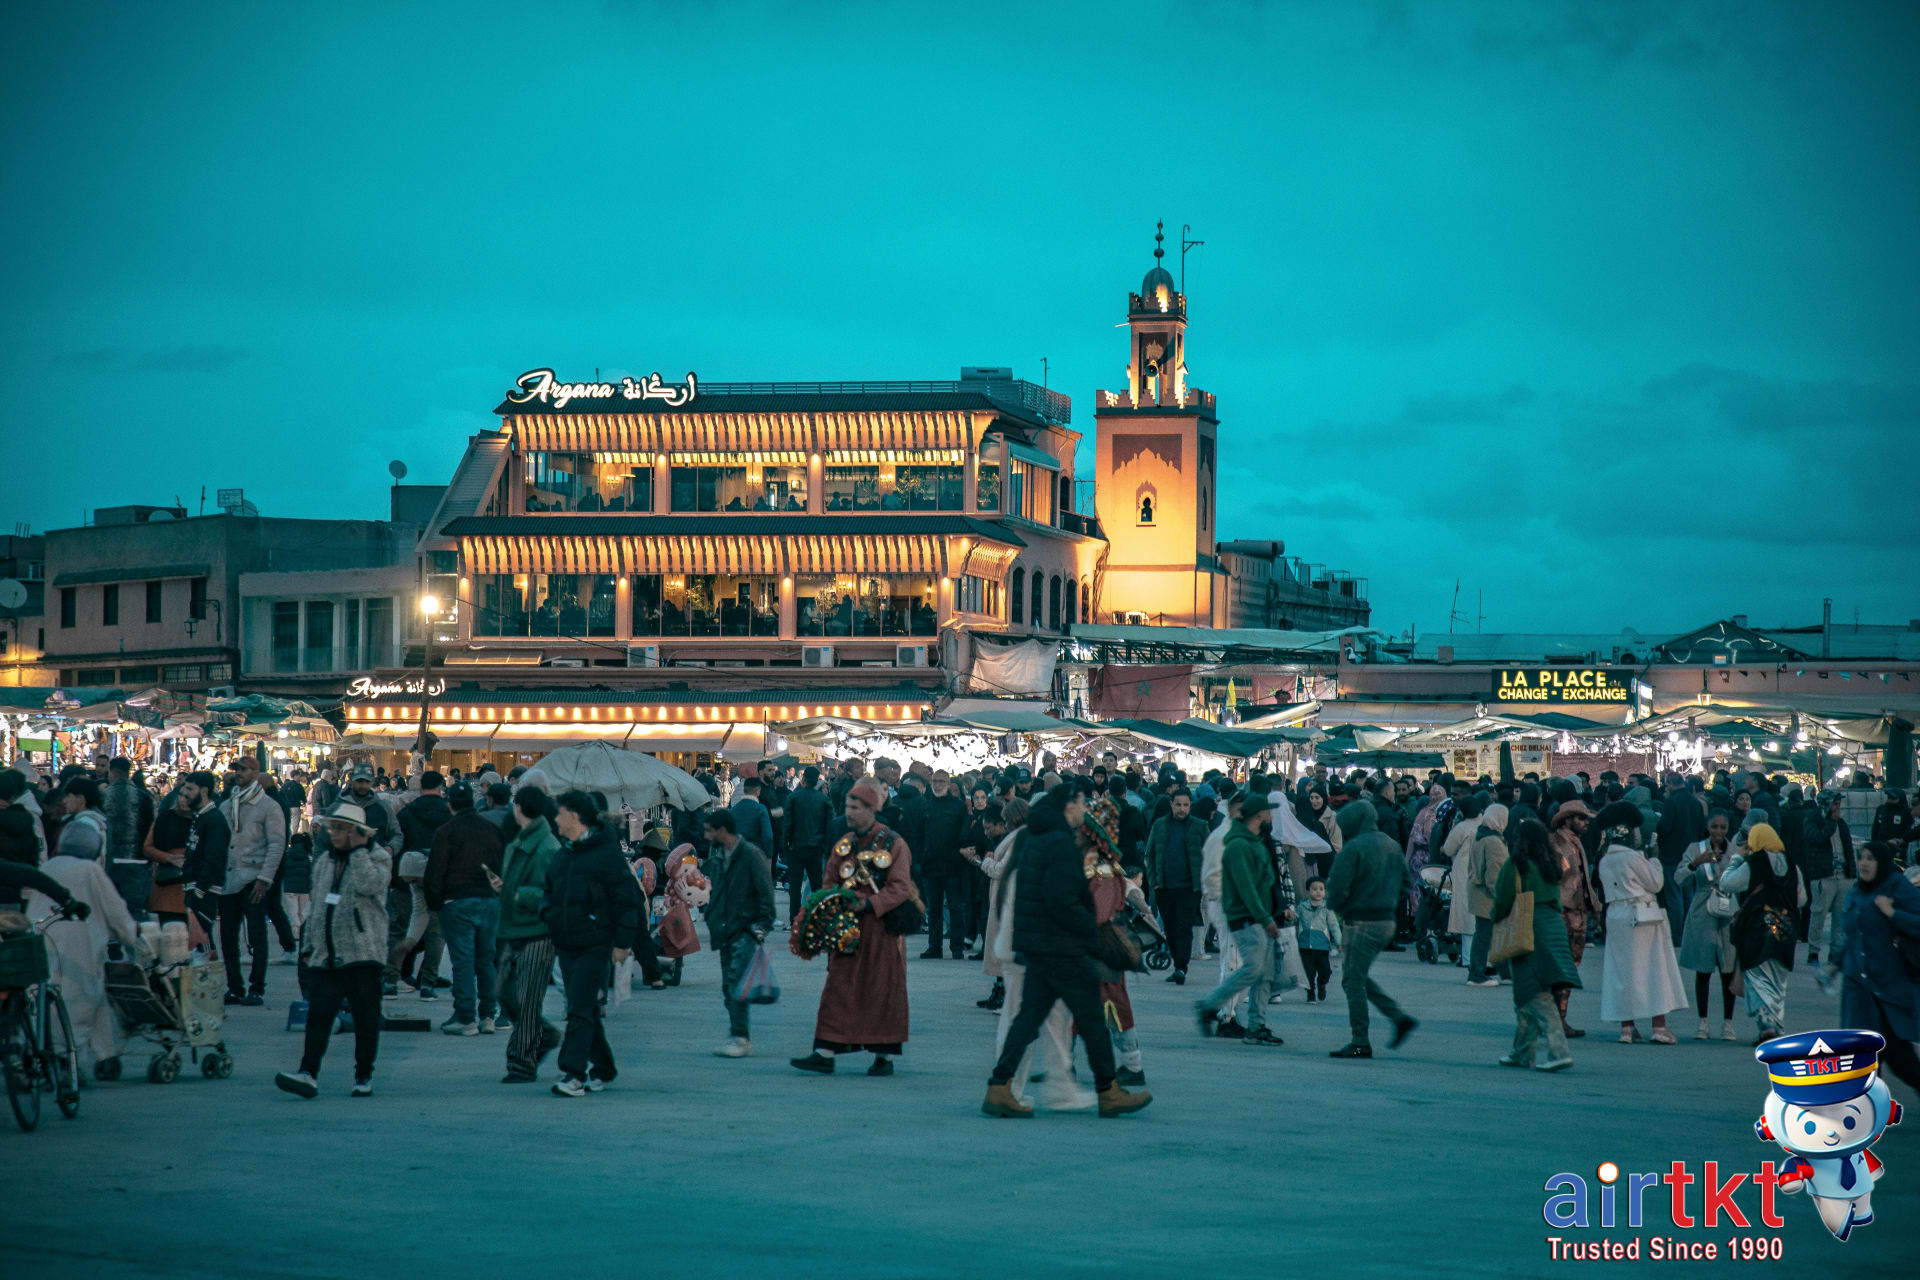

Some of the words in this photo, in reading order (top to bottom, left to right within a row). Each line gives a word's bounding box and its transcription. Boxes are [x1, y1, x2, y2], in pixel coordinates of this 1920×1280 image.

[508, 369, 614, 409] Argana
[347, 677, 403, 699] Argana
[1501, 670, 1528, 687] LA
[1539, 670, 1606, 687] PLACE
[1498, 687, 1548, 700] CHANGE
[1562, 687, 1627, 700] EXCHANGE
